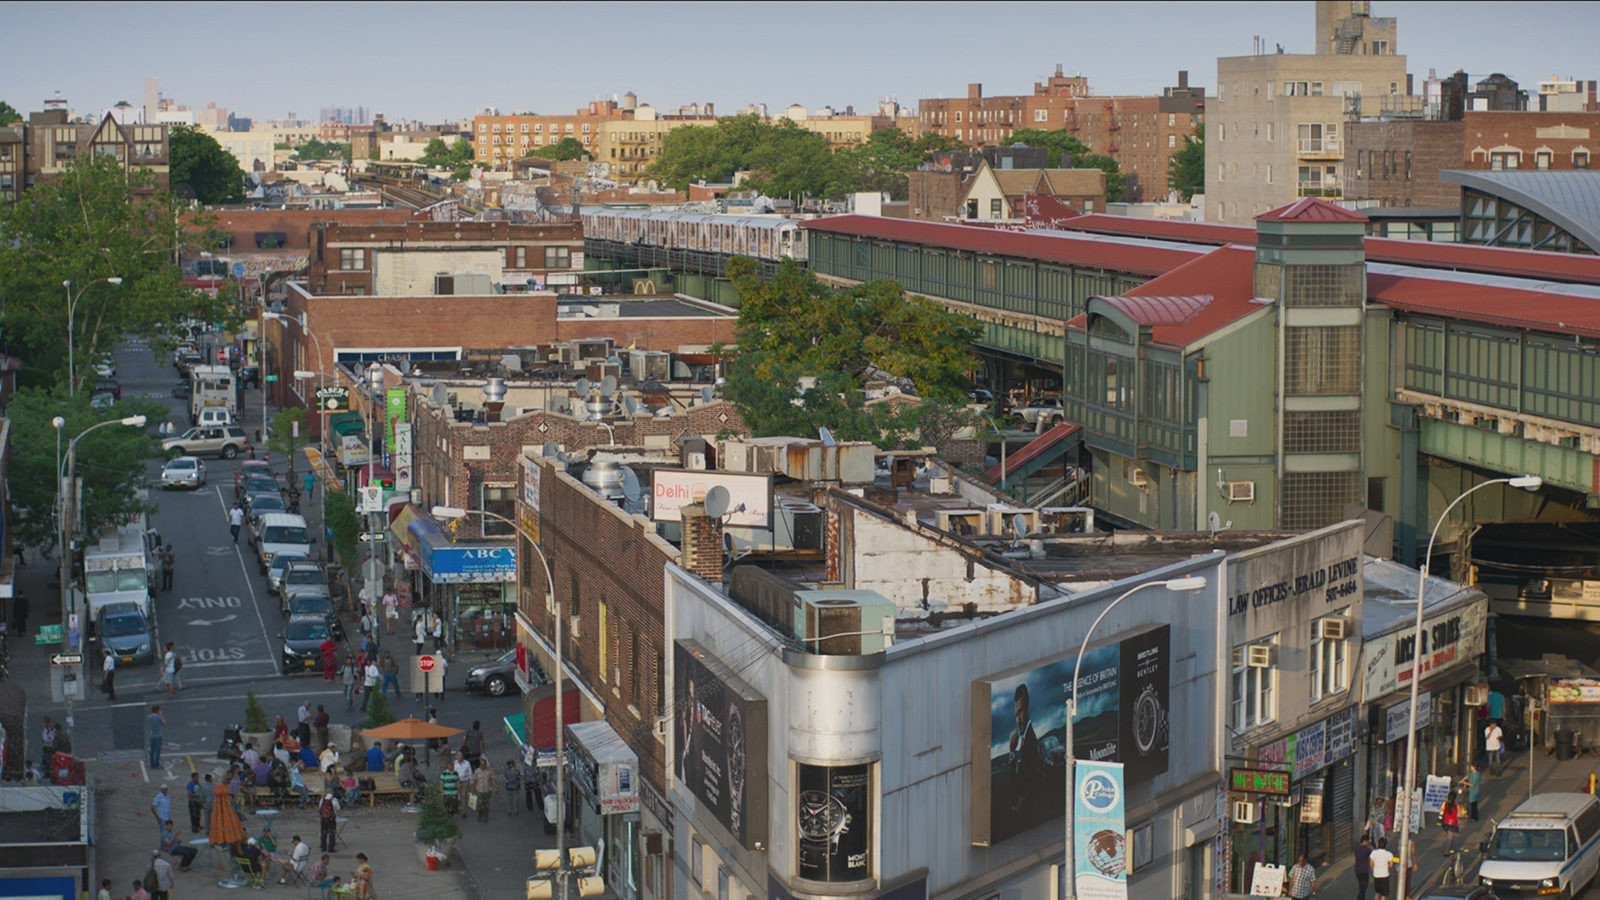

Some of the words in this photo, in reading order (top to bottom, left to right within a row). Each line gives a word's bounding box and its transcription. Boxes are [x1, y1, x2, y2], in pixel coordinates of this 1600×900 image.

[377, 353, 408, 361] CHASE
[655, 483, 690, 499] Delhi
[1229, 593, 1249, 616] LAW
[1252, 582, 1288, 609] OFFICES
[1292, 569, 1326, 596] JERALD
[1328, 557, 1358, 583] LEVINE
[178, 596, 241, 609] ONLY
[1137, 664, 1159, 678] BENTLEY
[1063, 682, 1073, 693] THE
